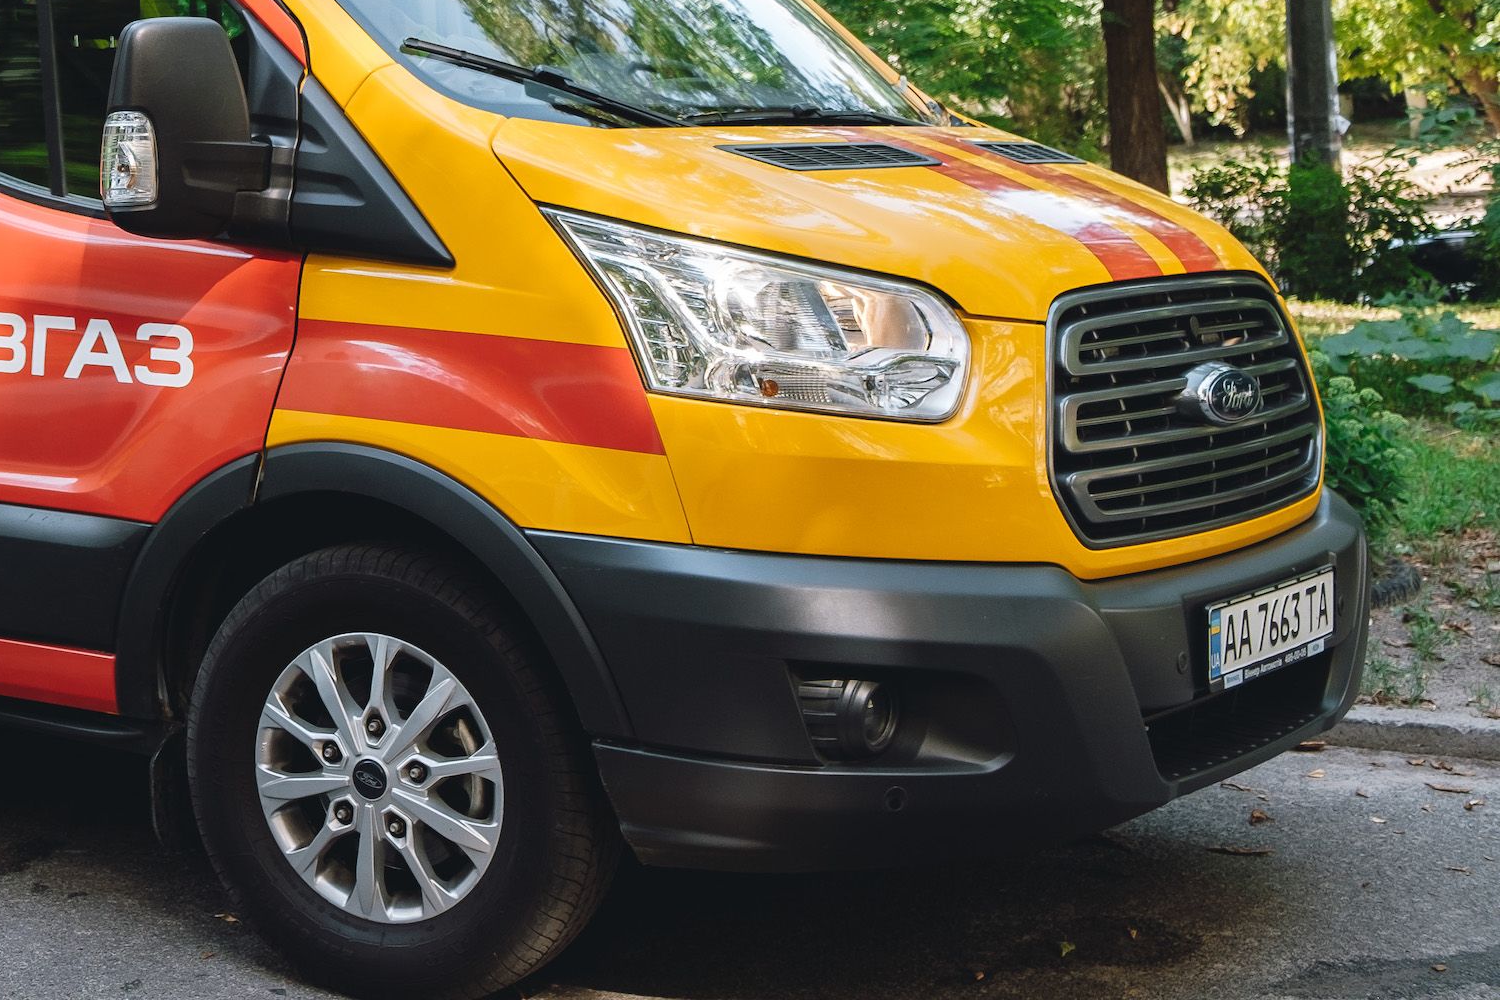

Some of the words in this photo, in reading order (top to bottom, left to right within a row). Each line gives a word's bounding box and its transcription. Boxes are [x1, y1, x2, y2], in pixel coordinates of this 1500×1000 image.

[1222, 378, 1255, 412] Ford
[1223, 609, 1252, 665] AA
[1258, 592, 1301, 653] 7663
[1305, 582, 1329, 633] TA
[1211, 653, 1220, 669] UA
